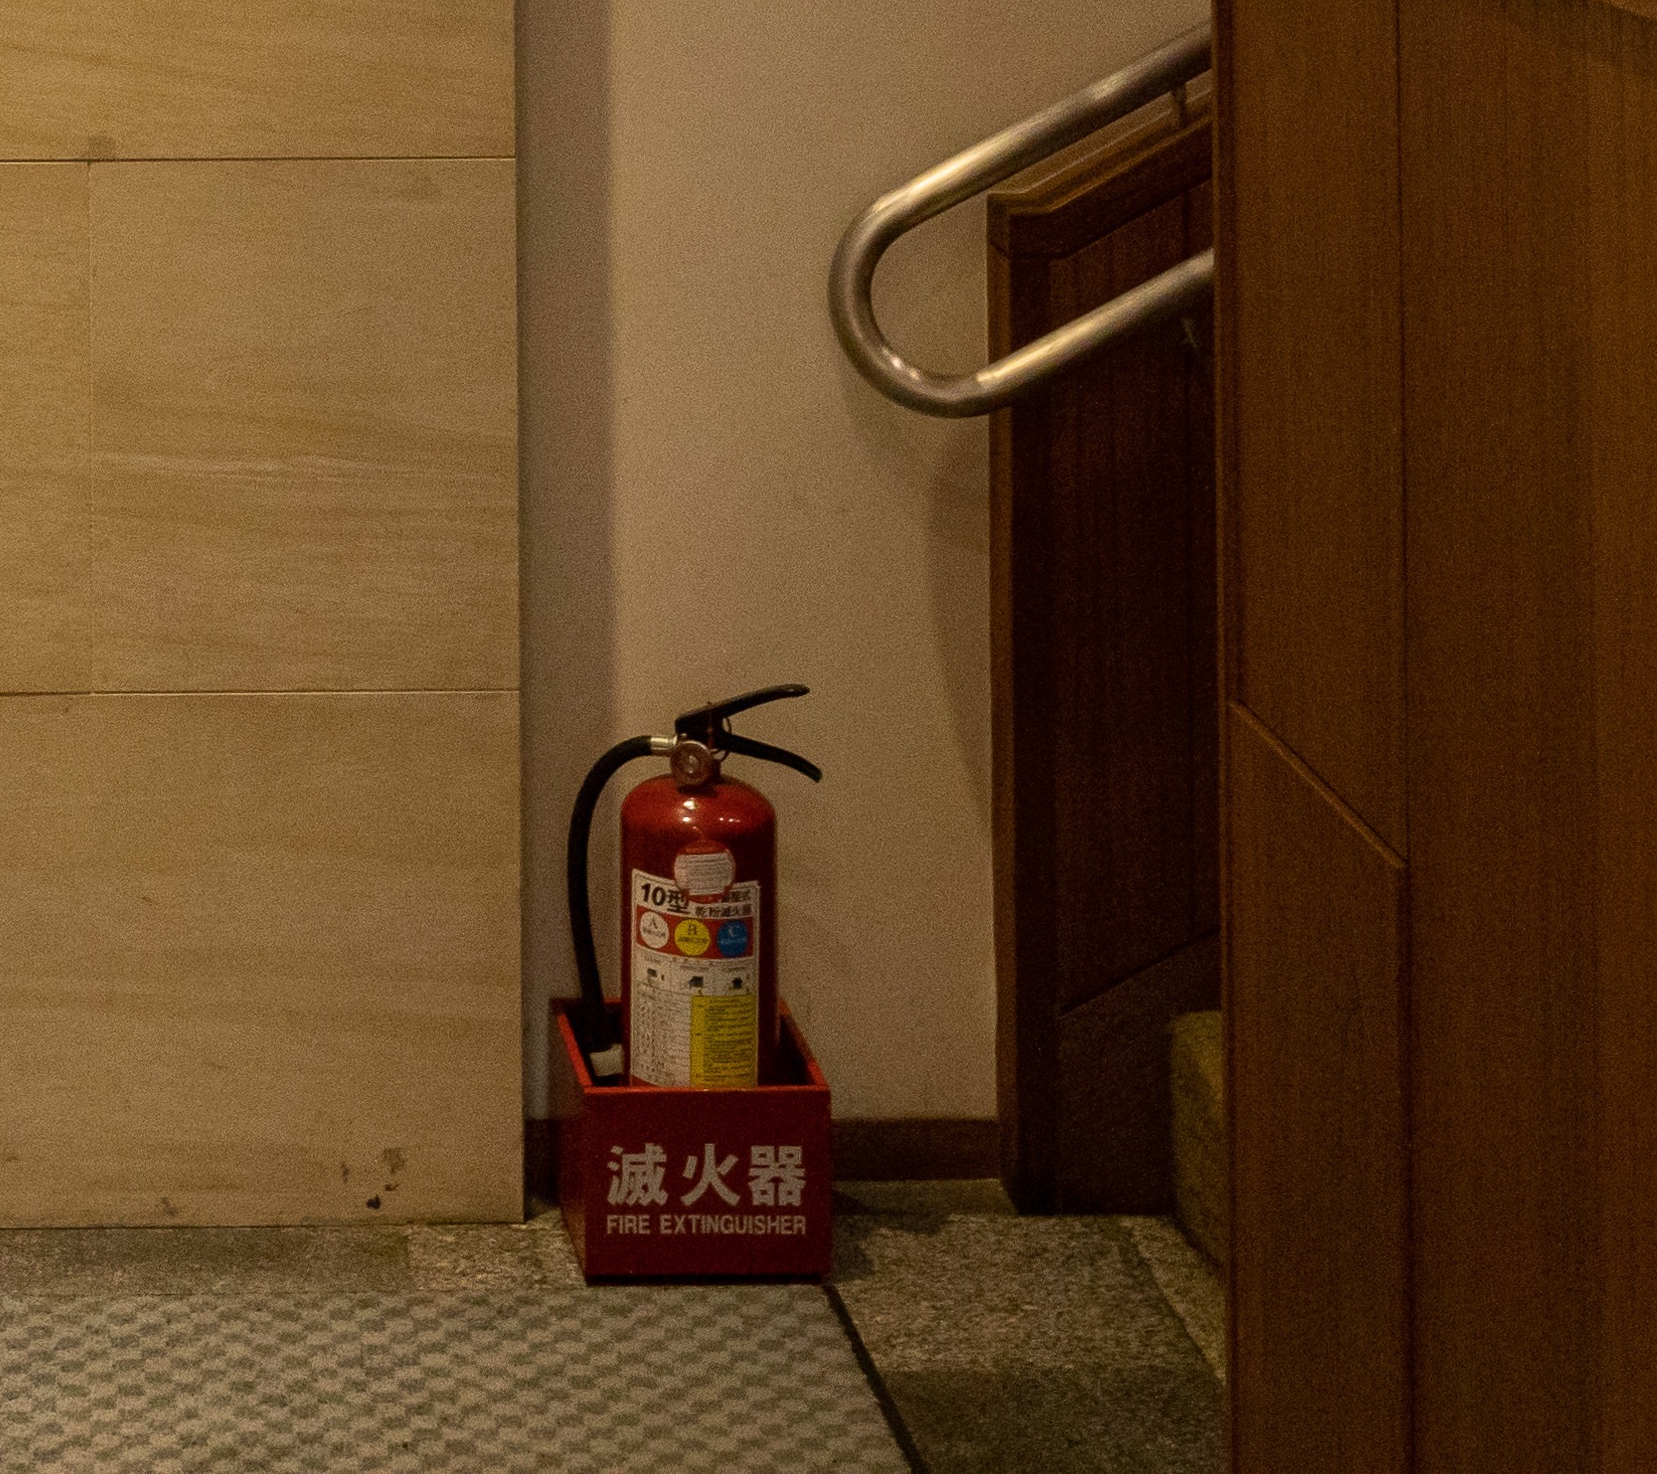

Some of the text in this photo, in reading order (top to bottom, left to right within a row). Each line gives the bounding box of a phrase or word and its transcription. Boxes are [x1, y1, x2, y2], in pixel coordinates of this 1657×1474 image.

[606, 1143, 807, 1207] 滅火器
[607, 1214, 807, 1235] FIRE EXTINGUISHER
